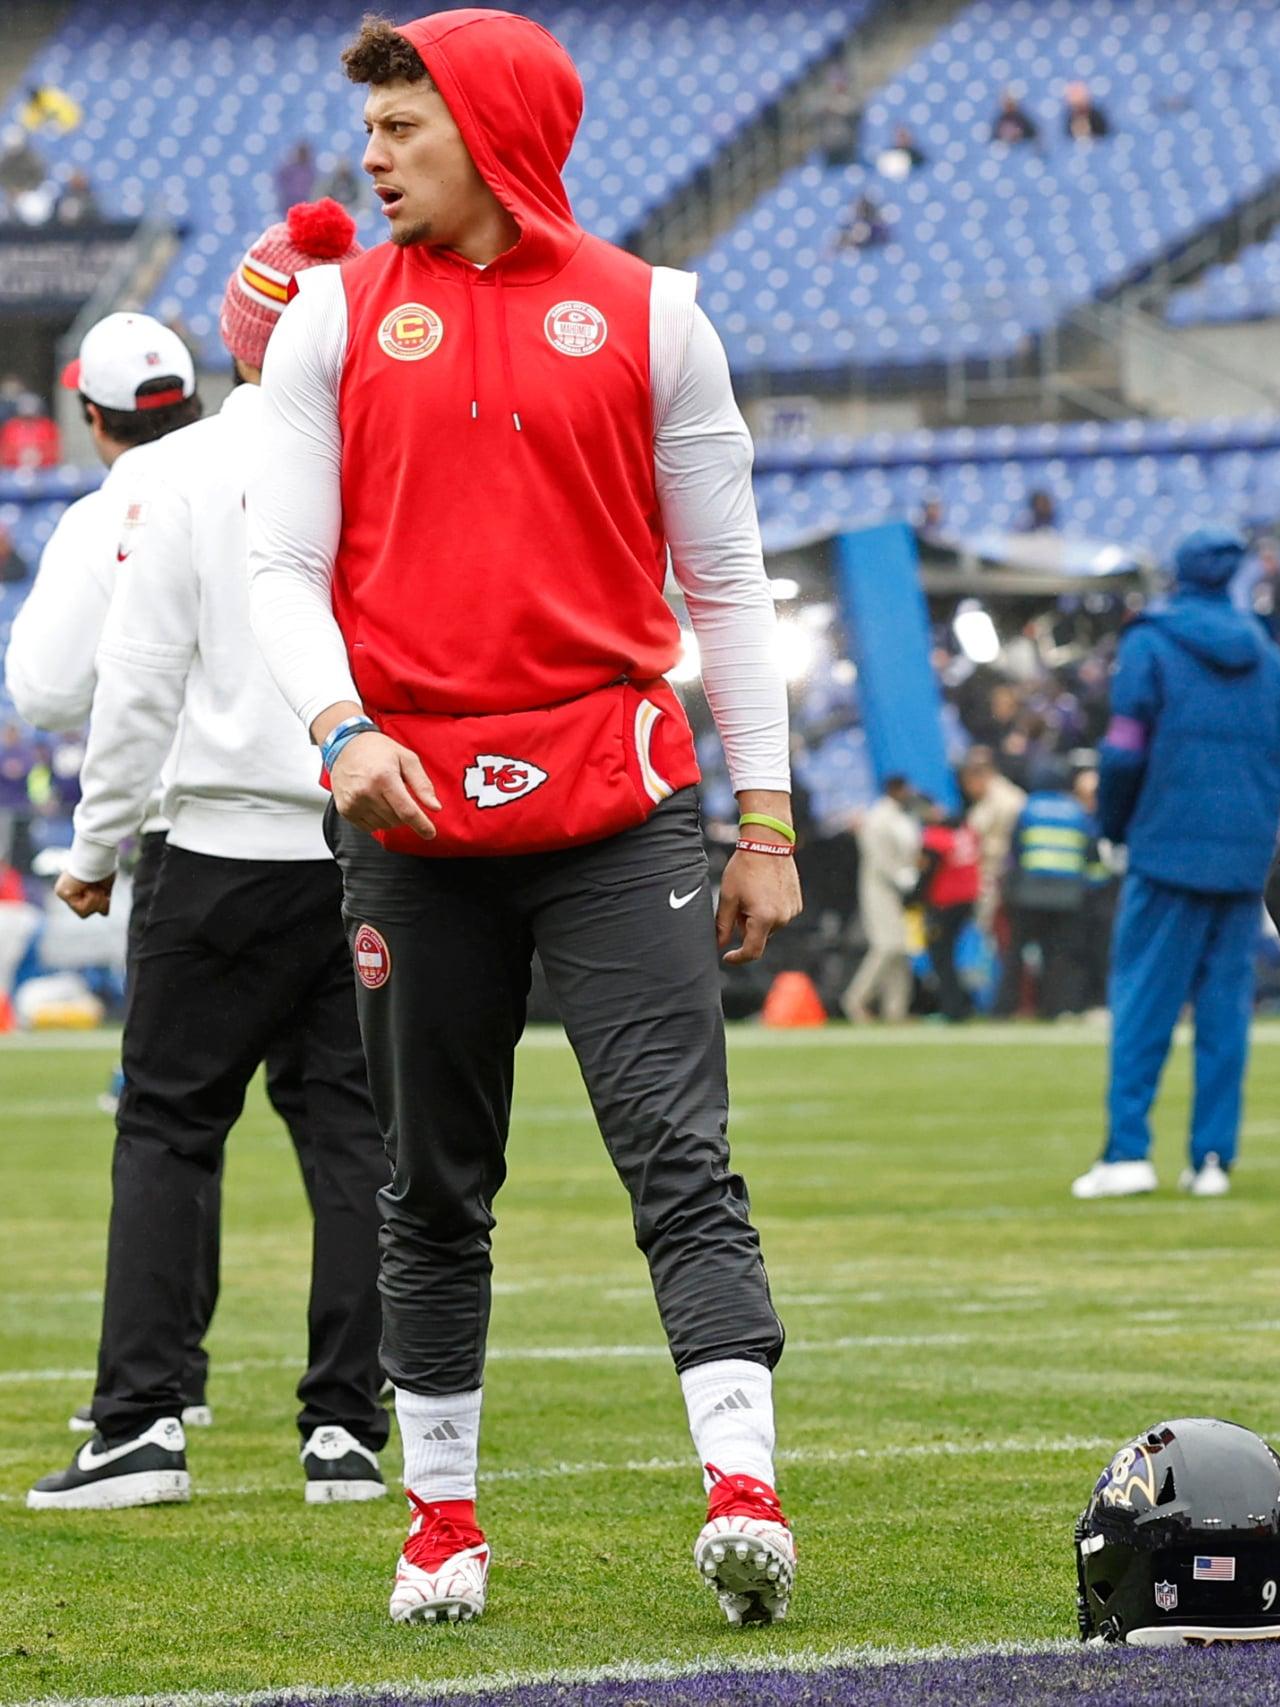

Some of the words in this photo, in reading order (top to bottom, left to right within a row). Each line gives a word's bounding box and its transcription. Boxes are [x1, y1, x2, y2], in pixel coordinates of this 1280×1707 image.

[396, 317, 425, 339] C
[483, 765, 529, 793] KC
[1158, 1593, 1175, 1606] NFL
[1261, 1580, 1278, 1611] 9
